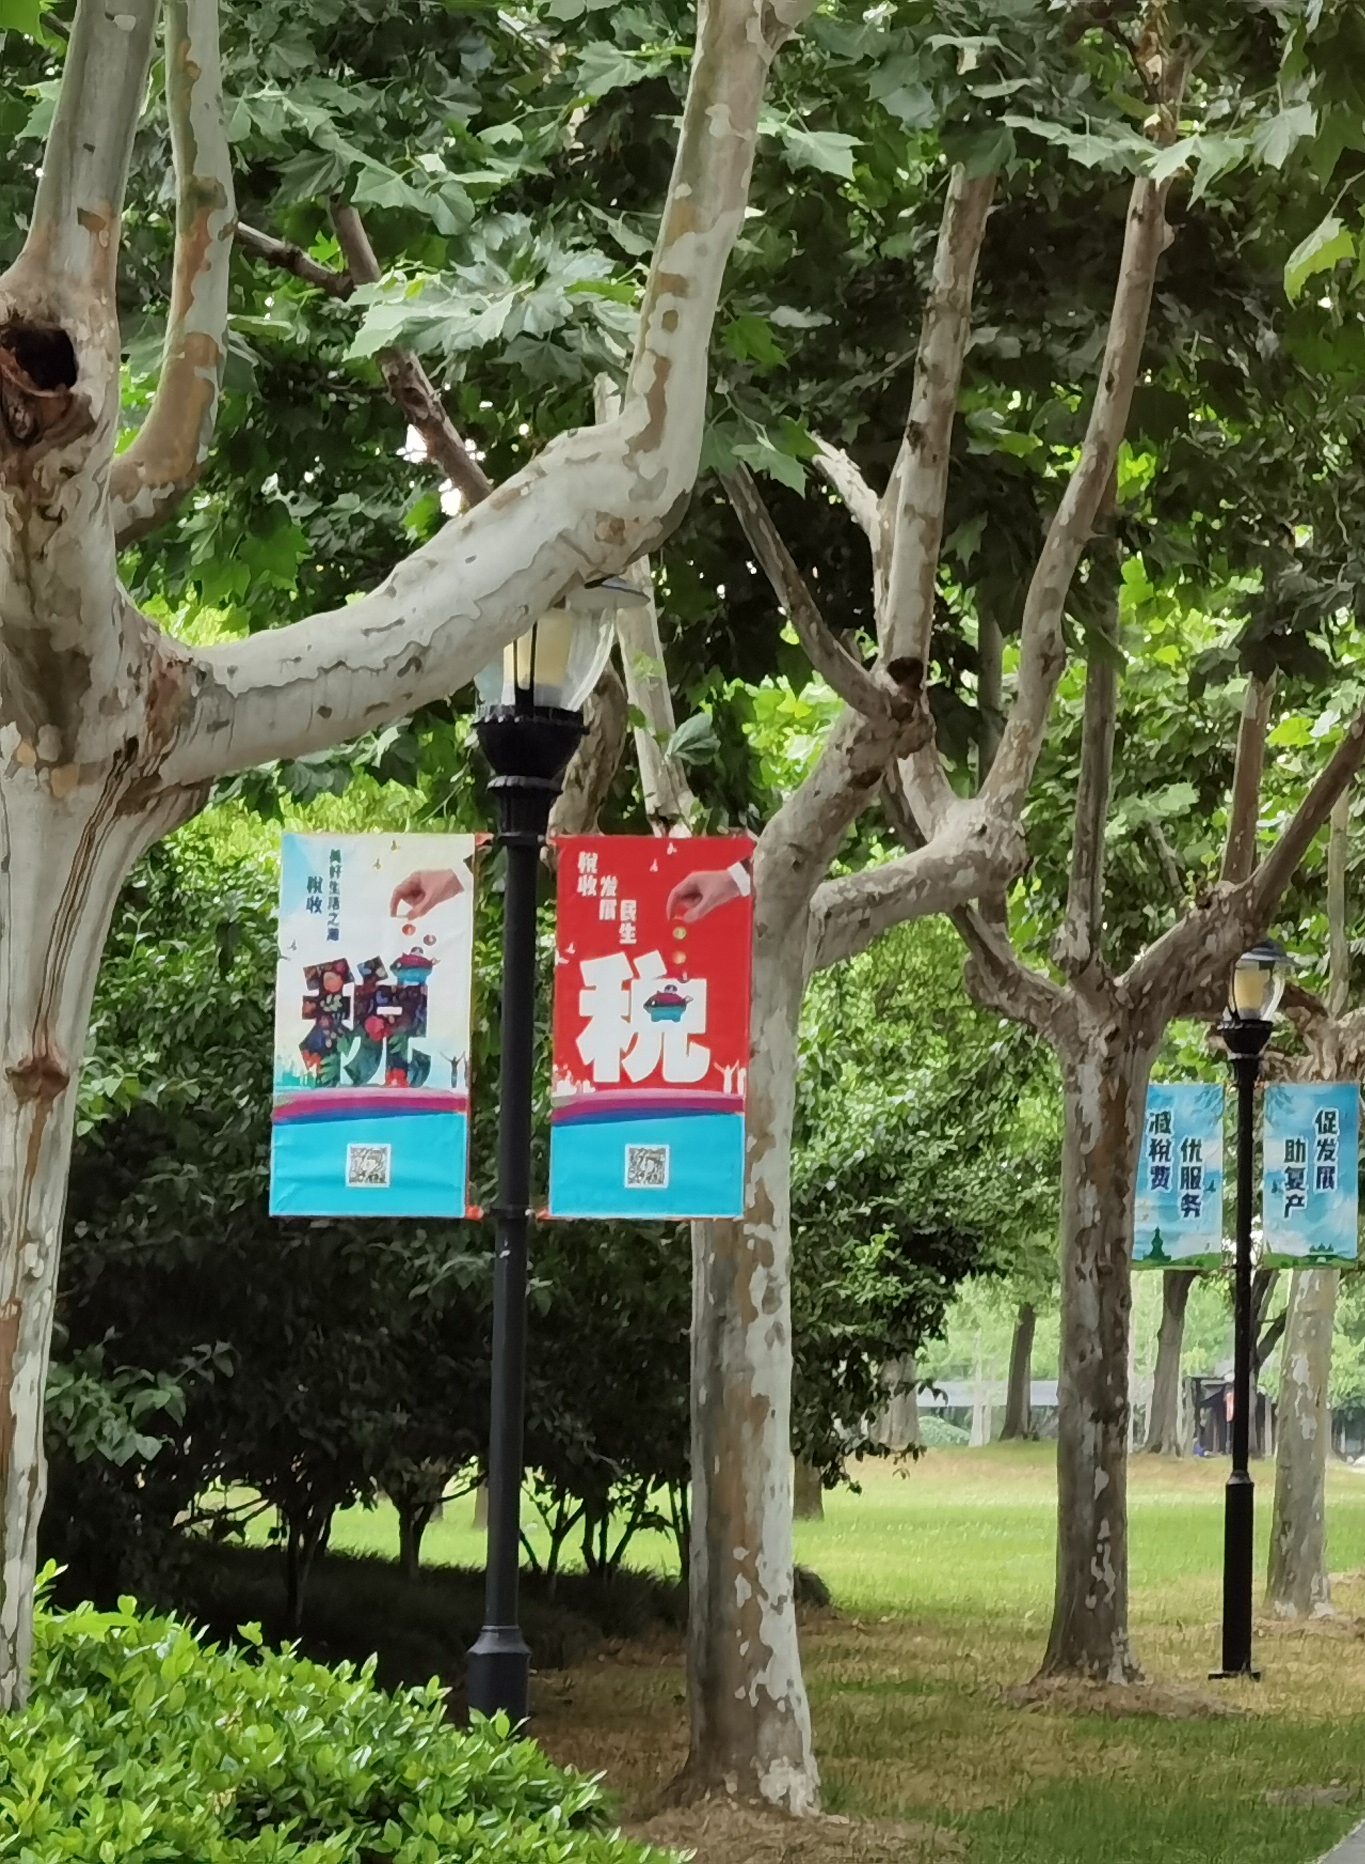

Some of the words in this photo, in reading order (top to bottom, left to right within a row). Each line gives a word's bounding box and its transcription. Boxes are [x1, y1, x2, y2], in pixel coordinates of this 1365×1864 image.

[576, 950, 711, 1083] 税
[1148, 1111, 1172, 1191] 减税费
[1180, 1138, 1203, 1218] 优服务
[1284, 1139, 1306, 1218] 助复产
[1315, 1110, 1339, 1190] 促发展
